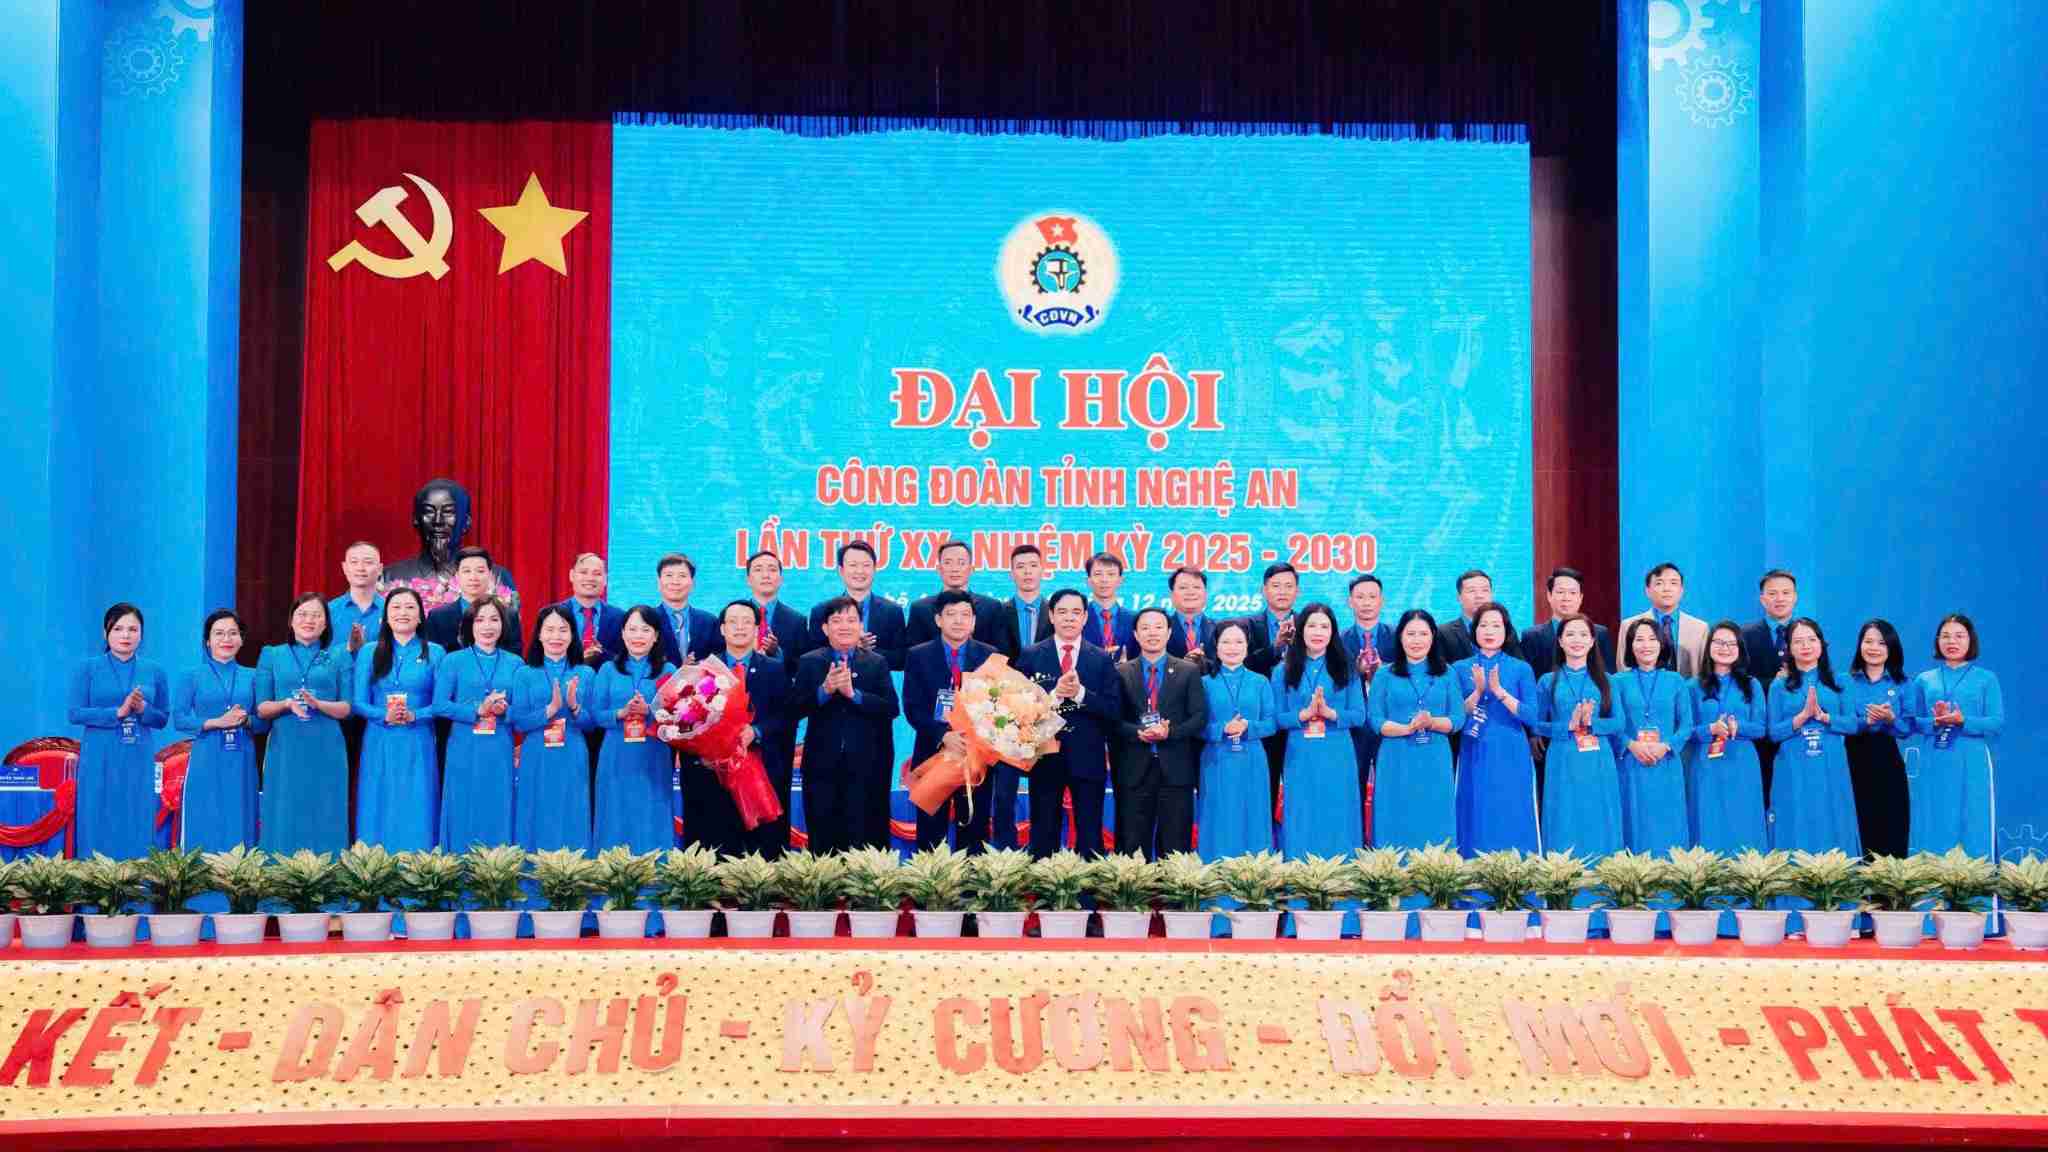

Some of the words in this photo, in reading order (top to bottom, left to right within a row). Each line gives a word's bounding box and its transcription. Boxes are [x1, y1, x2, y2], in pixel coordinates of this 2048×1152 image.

[891, 368, 1040, 449] ĐẠI
[1059, 353, 1224, 451] HỘI
[817, 457, 918, 505] CÔNG
[930, 457, 1031, 505] ĐOÀN
[1042, 455, 1125, 507] TỈNH
[1136, 460, 1235, 517] NGHỆ
[1245, 468, 1298, 508] AN
[1104, 522, 1152, 571] KỲ
[1162, 532, 1252, 573] 2025
[1260, 550, 1279, 561] -
[1287, 532, 1377, 574] 2030
[1213, 593, 1264, 612] 2025
[0, 983, 204, 1088] KẾT
[271, 986, 482, 1083] DÂN
[503, 972, 688, 1076] CHỦ
[780, 971, 894, 1073] KỶ
[933, 990, 1232, 1075] CƯƠNG
[1760, 993, 2017, 1084] PHÁT
